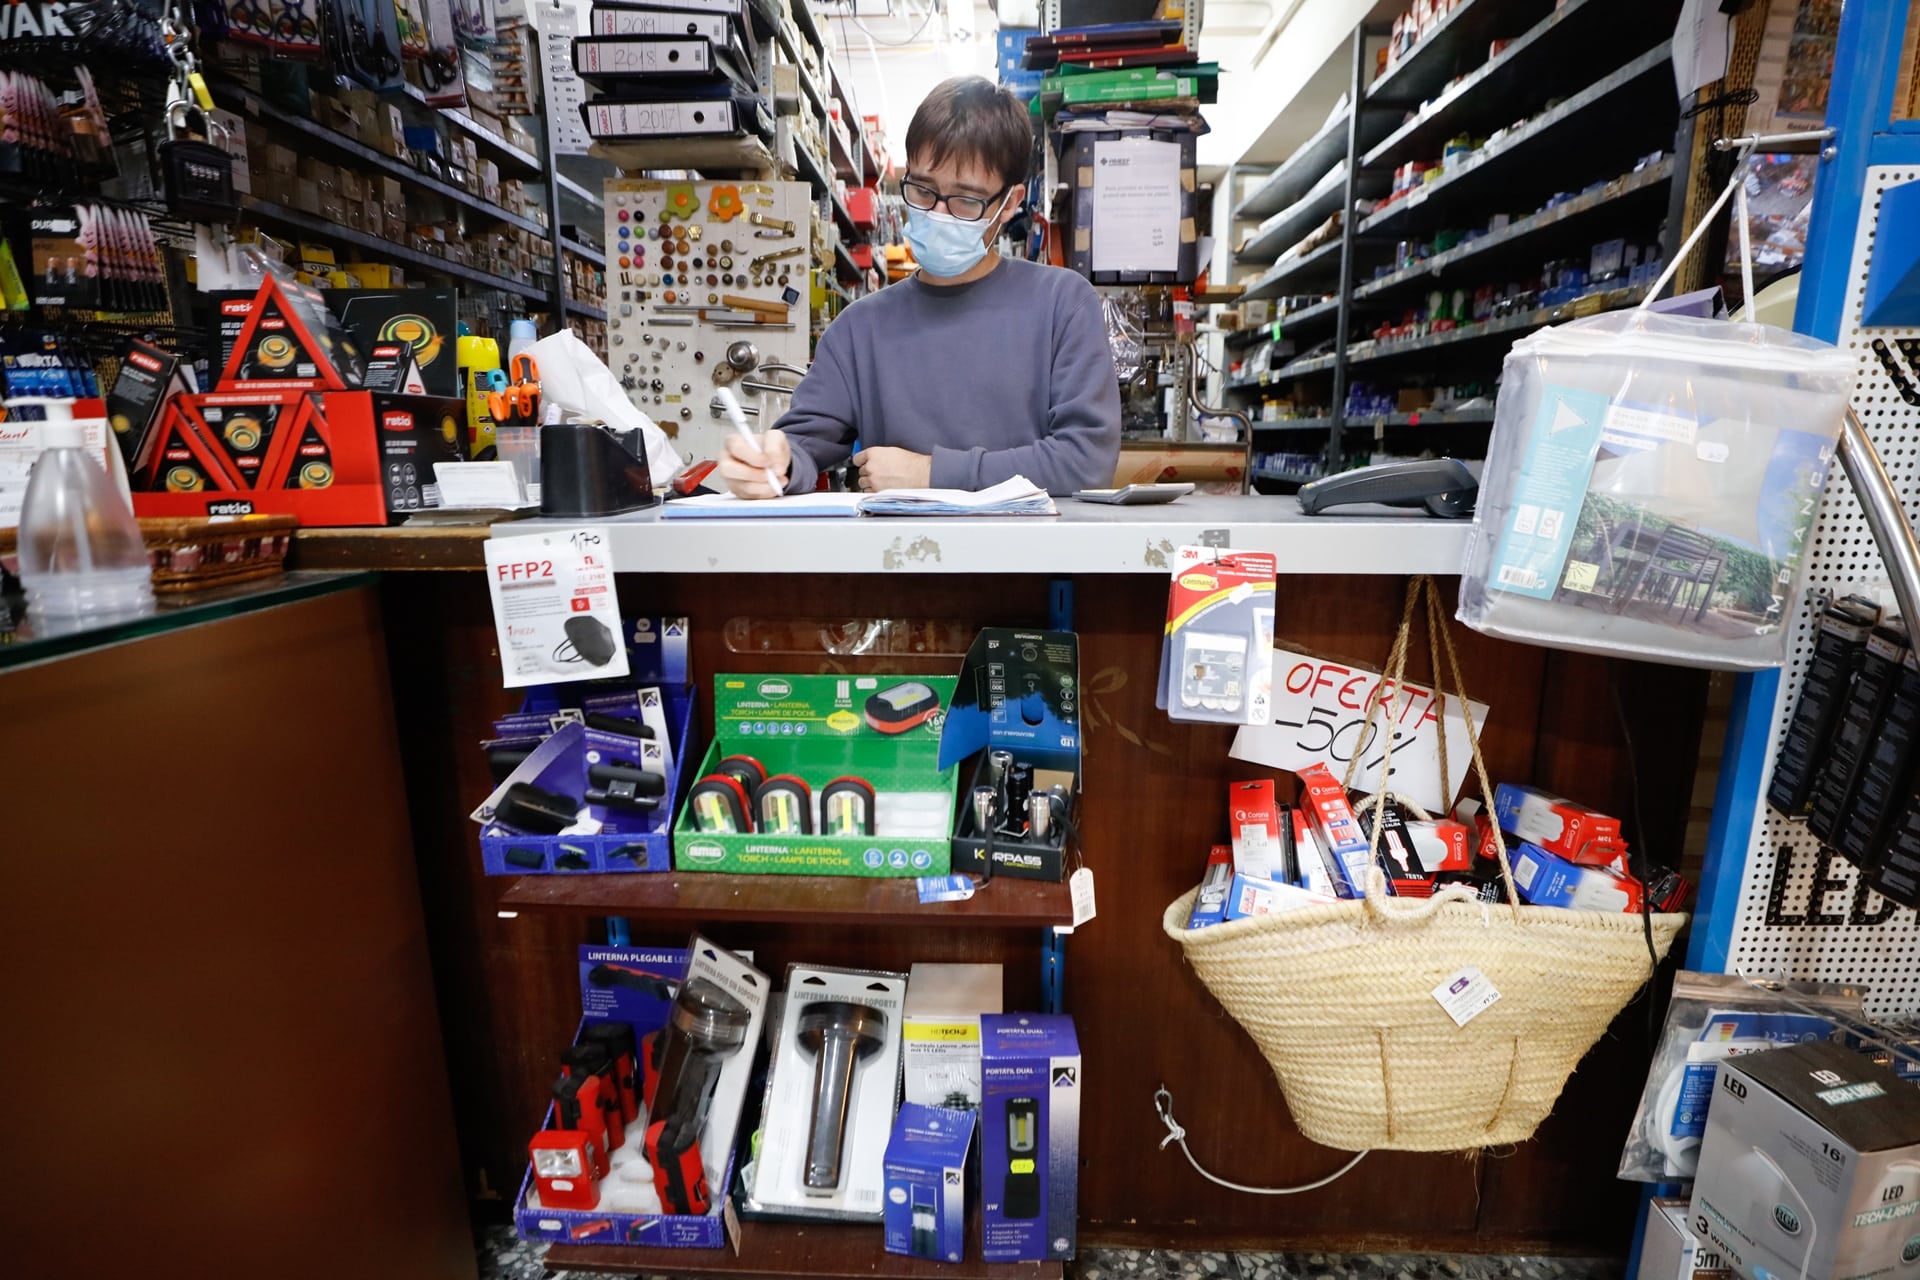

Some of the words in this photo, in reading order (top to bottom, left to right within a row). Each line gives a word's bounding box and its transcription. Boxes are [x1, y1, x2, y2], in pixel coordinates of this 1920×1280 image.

[623, 16, 655, 34] 2019
[615, 49, 656, 66] 2018
[639, 109, 674, 129] 2017
[224, 303, 254, 313] rati
[385, 414, 412, 427] ratio
[210, 502, 252, 515] ratio
[1181, 550, 1199, 560] 3M
[497, 559, 555, 583] FFP2
[1286, 662, 1446, 730] OFERTA
[736, 701, 770, 709] LINTERNA
[773, 702, 810, 710] LANTERNA
[1060, 736, 1075, 747] LED
[1247, 811, 1270, 820] Corona
[745, 844, 789, 854] LINTERNA
[794, 847, 842, 857] LANTERNA
[974, 847, 1042, 870] KRPASS
[737, 855, 769, 863] TORCH
[774, 855, 806, 865] LAMPE
[820, 859, 850, 867] POCHE
[1404, 872, 1425, 881] TESTA
[1764, 846, 1897, 926] LED
[588, 951, 629, 962] LINTERNA
[630, 953, 673, 964] PLEGABLE
[794, 991, 828, 1001] LINTERNA
[864, 997, 897, 1008] SOPORTE
[1809, 1069, 1841, 1084] LED
[1723, 1073, 1748, 1099] LED
[1821, 1081, 1885, 1104] TECH-LIGHT
[1821, 1141, 1841, 1162] 16
[1881, 1184, 1905, 1202] LED
[1854, 1199, 1920, 1228] TECH-LIGHT
[1695, 1214, 1709, 1235] 3
[1710, 1231, 1742, 1266] WATTS
[1694, 1247, 1720, 1268] 5m
